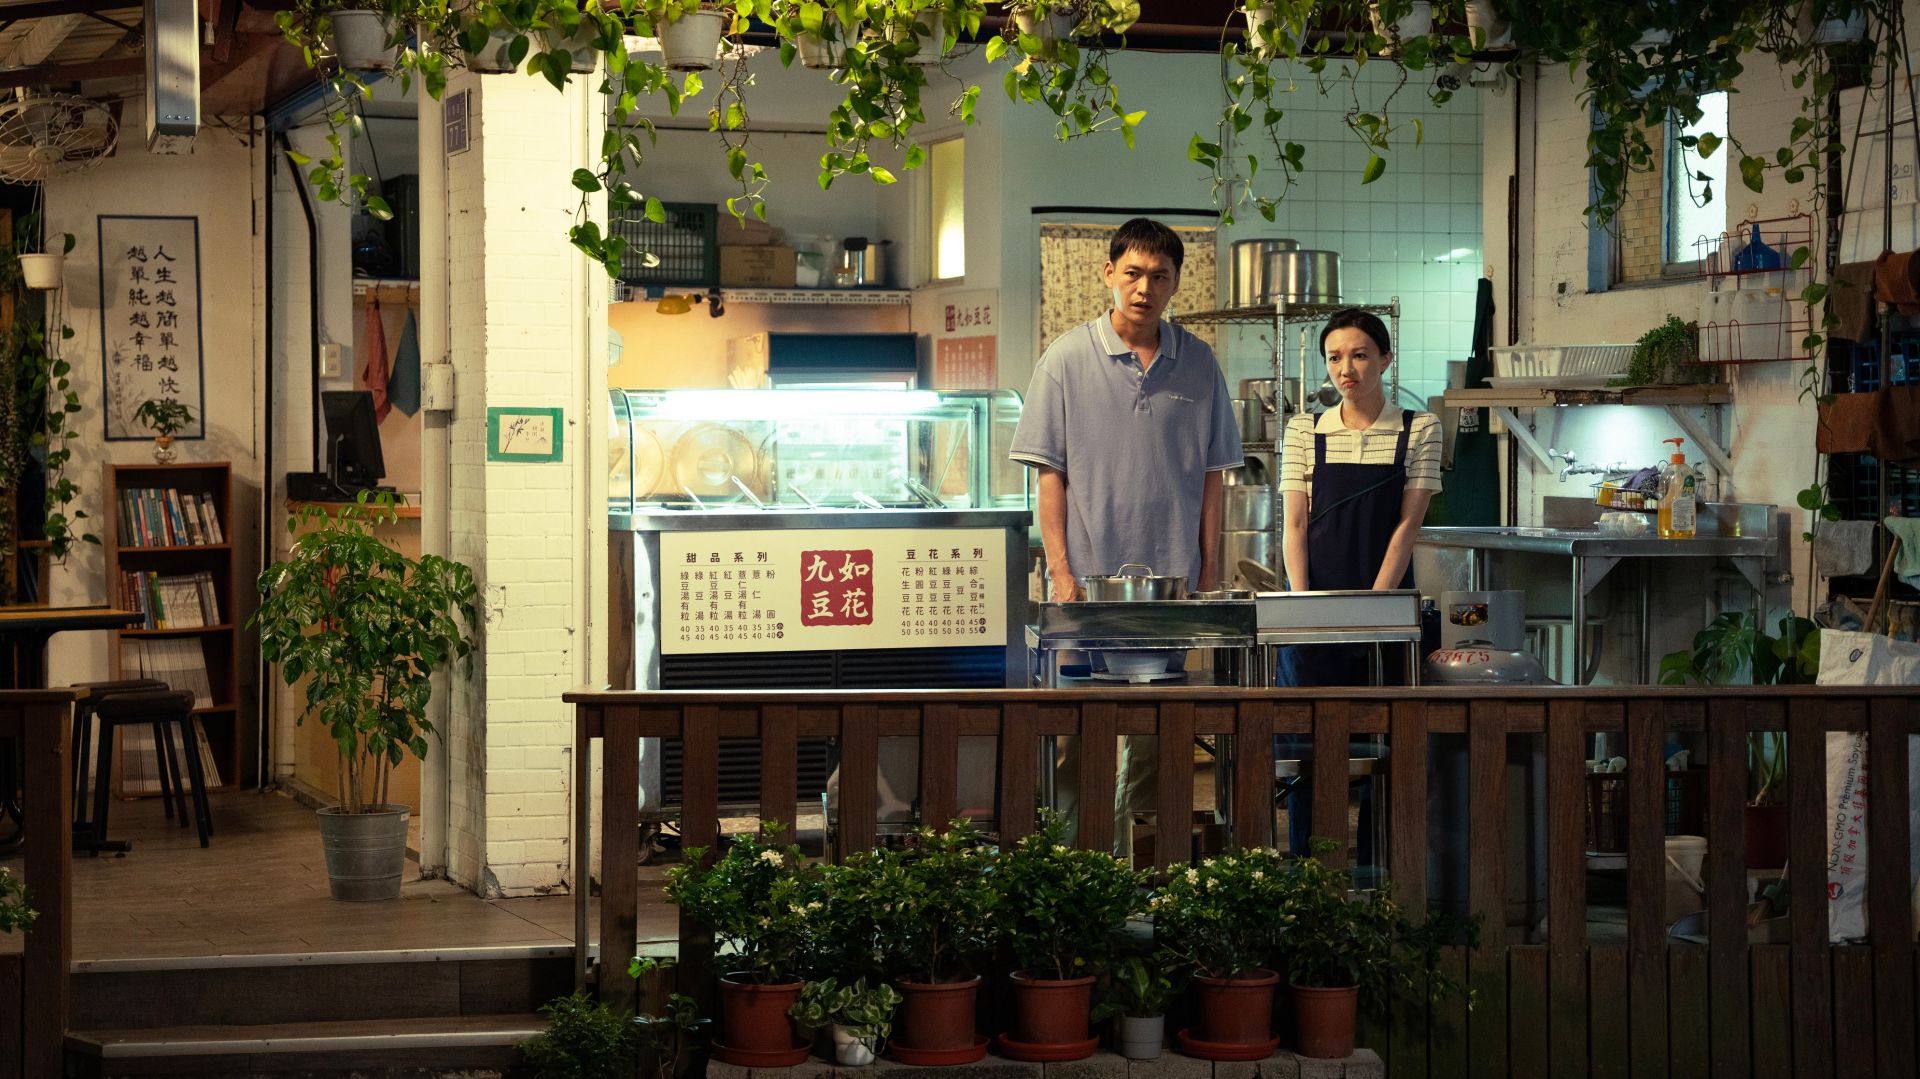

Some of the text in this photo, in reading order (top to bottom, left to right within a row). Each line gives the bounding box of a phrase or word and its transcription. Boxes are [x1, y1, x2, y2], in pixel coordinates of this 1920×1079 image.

[127, 245, 153, 372] 越單純越幸福
[153, 245, 180, 411] 人生越簡單越快
[686, 552, 768, 563] 甜品系列
[804, 553, 870, 583] 九如
[906, 548, 983, 560] 豆花系列
[807, 588, 870, 619] 豆花
[901, 567, 911, 616] 花生豆花
[928, 566, 938, 616] 紅豆豆花
[680, 625, 690, 633] 40
[723, 624, 734, 632] 35
[1828, 813, 1847, 872] NON-GMO
[1839, 767, 1856, 809] Premium
